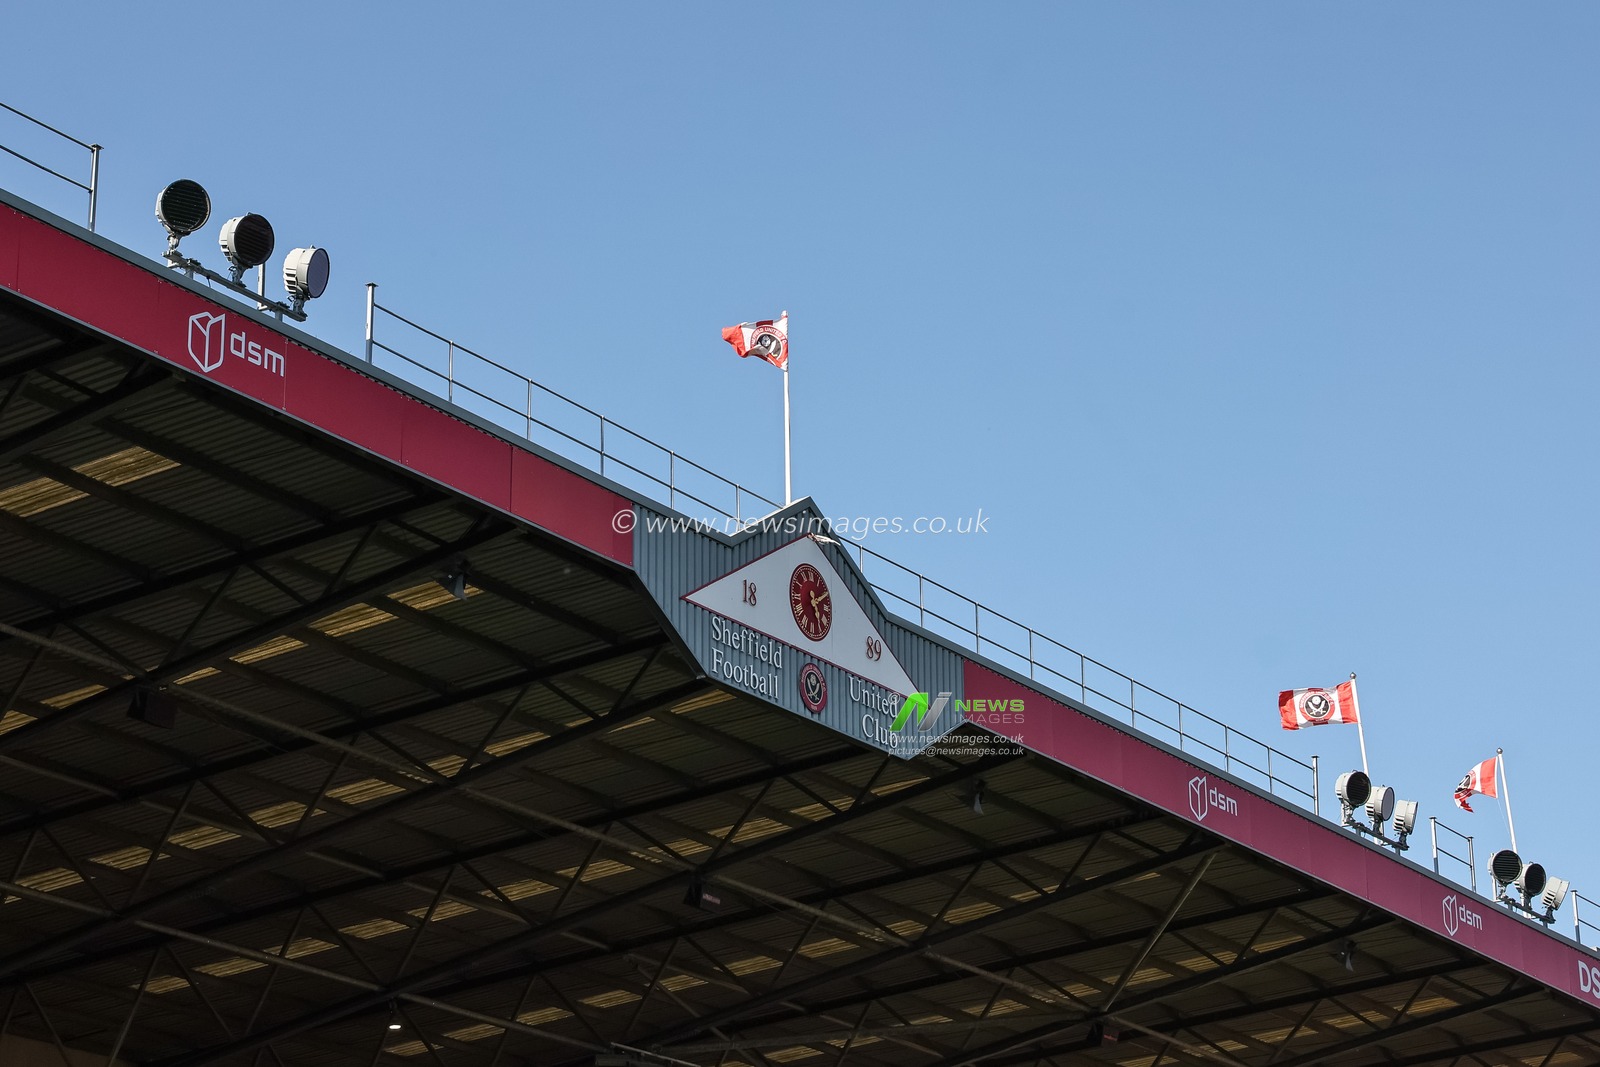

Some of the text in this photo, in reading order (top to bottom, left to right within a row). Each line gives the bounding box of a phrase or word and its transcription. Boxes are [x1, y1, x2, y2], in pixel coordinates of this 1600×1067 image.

[230, 331, 285, 377] dsm
[743, 579, 757, 606] 18
[711, 616, 782, 669] Sheffield
[866, 635, 882, 662] 89
[711, 647, 779, 699] Football
[848, 675, 898, 718] United
[862, 714, 898, 748] Club
[1209, 787, 1238, 817] dsm
[1458, 904, 1483, 931] dsm
